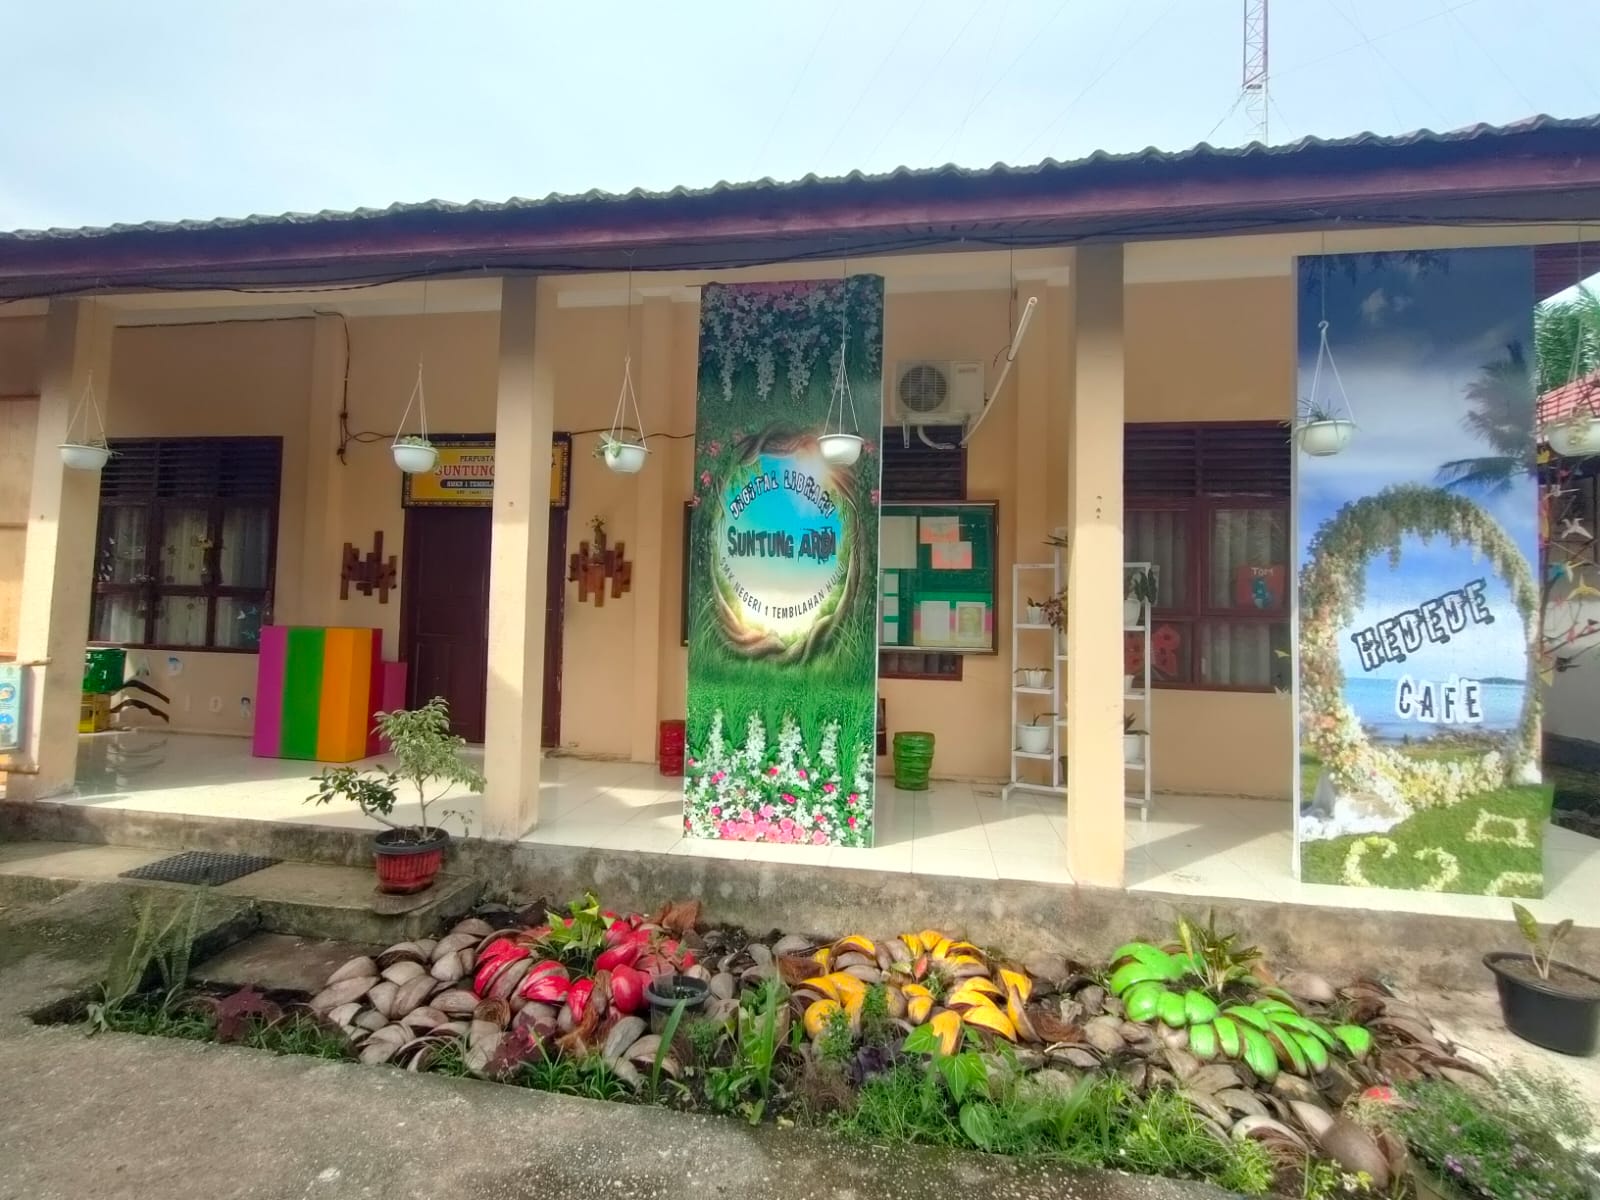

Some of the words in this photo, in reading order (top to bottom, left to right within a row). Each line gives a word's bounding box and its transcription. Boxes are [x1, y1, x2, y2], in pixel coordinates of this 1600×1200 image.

[729, 470, 779, 519] DIGITAL
[783, 470, 836, 519] LIBRARY
[727, 525, 794, 559] SUNTUNG
[733, 582, 762, 613] NEGERI
[764, 604, 769, 617] 1
[772, 591, 826, 619] TEMBILAHAN
[826, 563, 845, 593] HULU
[1397, 678, 1482, 721] CAFE
